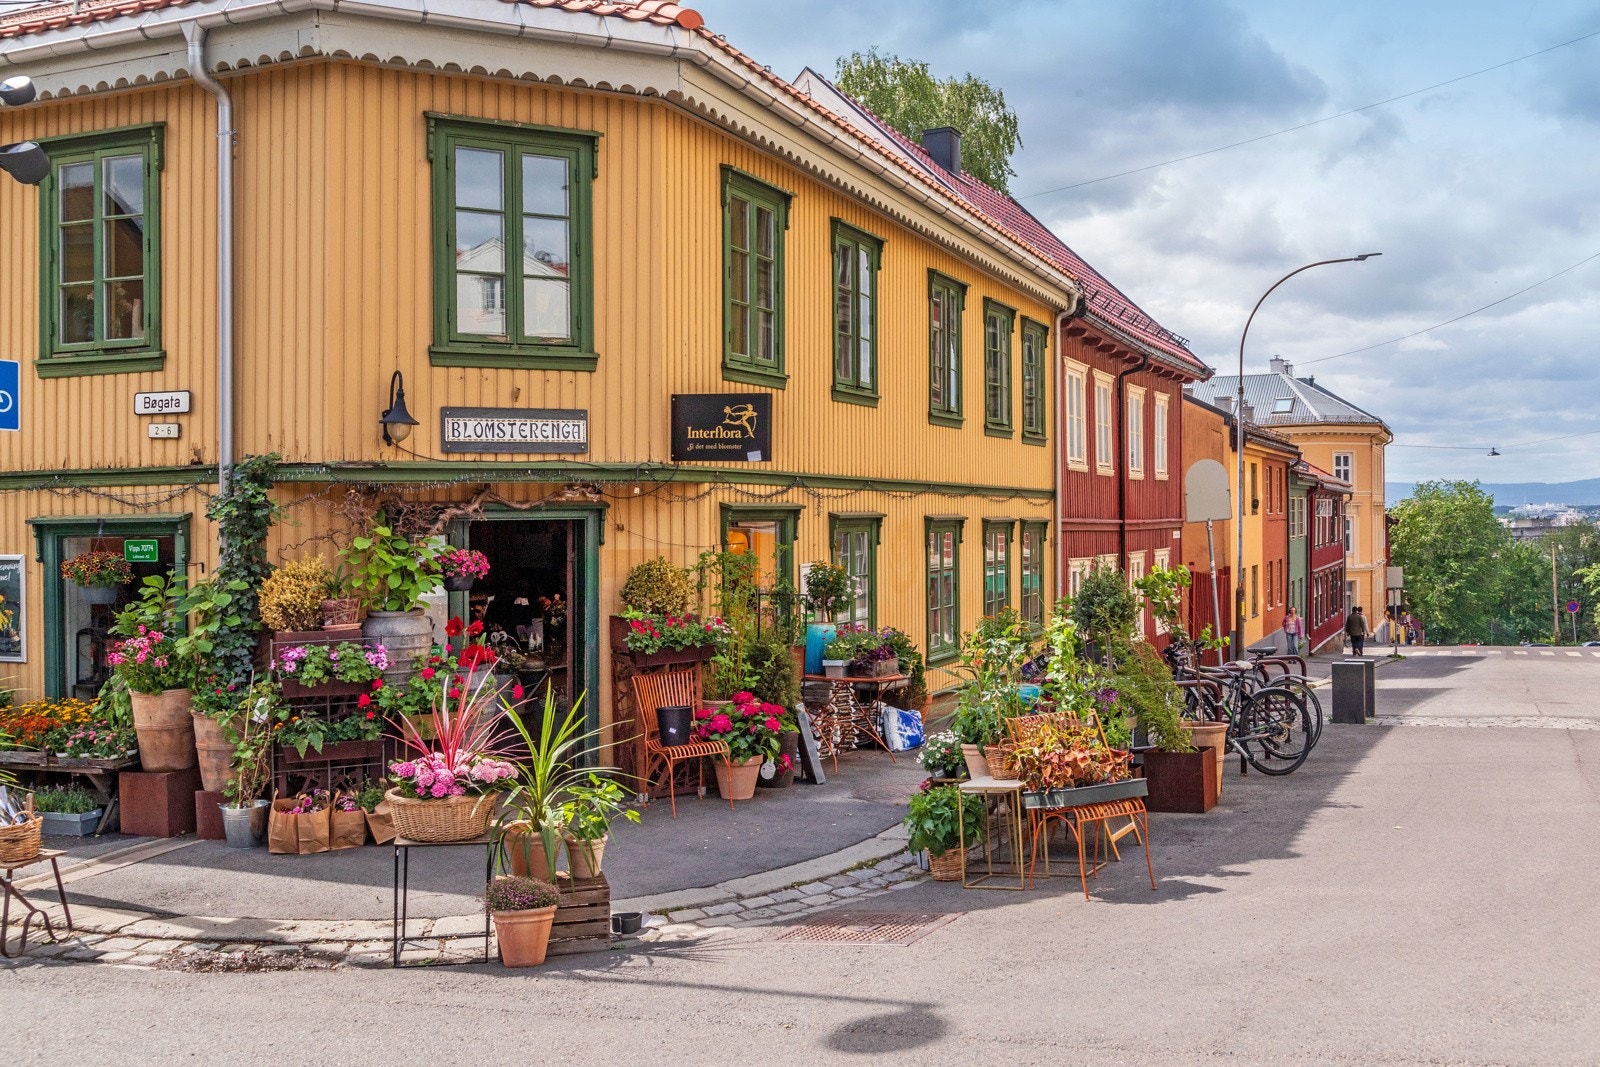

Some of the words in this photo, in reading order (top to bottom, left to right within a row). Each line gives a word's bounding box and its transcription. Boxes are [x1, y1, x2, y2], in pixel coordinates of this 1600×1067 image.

[143, 395, 181, 412] Bøgata
[451, 421, 581, 440] BLOMSTERENGA
[687, 425, 742, 439] Interflora
[128, 544, 140, 553] Vipps
